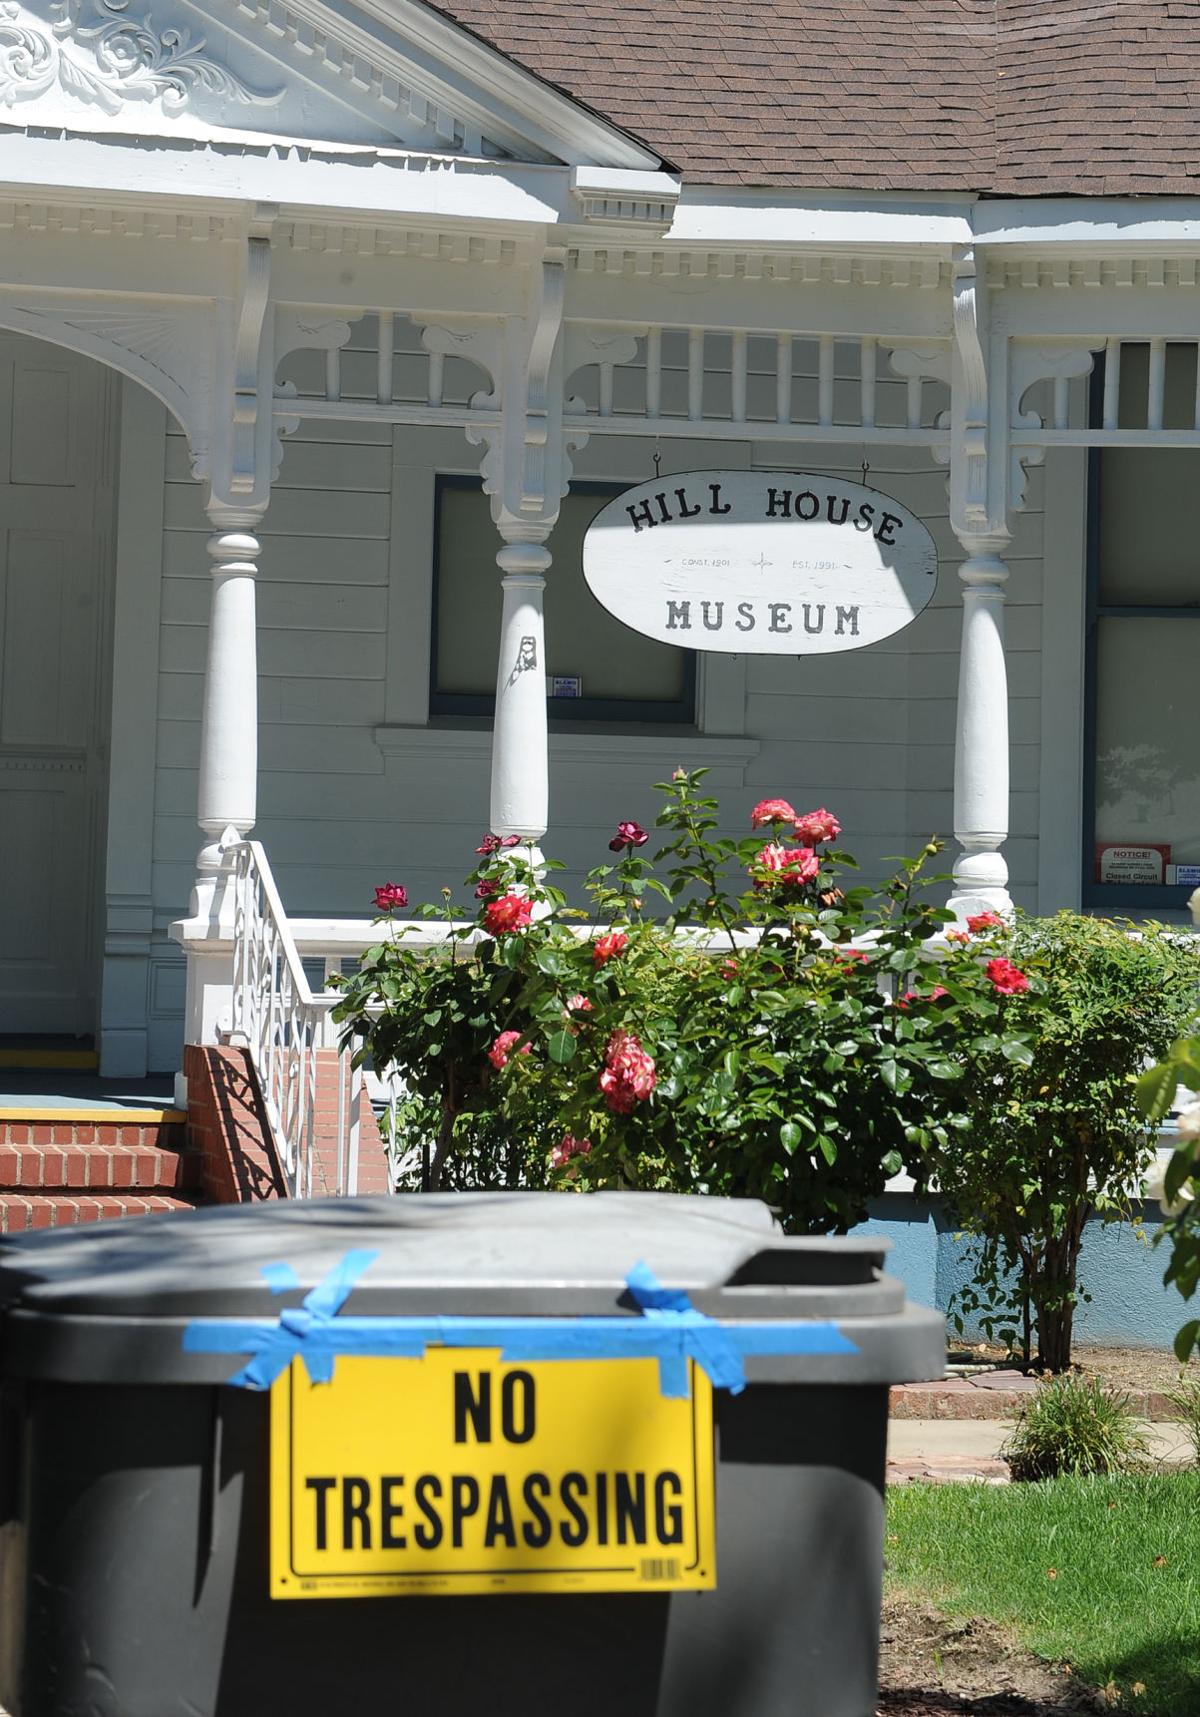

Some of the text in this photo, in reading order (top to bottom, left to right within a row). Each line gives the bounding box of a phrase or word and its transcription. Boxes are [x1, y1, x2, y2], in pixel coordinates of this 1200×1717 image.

[625, 484, 904, 545] HILL HOUSE
[665, 600, 860, 636] MUSEUM
[1106, 872, 1158, 881] Closed Circuit
[1113, 851, 1151, 859] NOTICE!
[453, 1369, 536, 1445] NO
[304, 1470, 685, 1551] TRESPASSING
